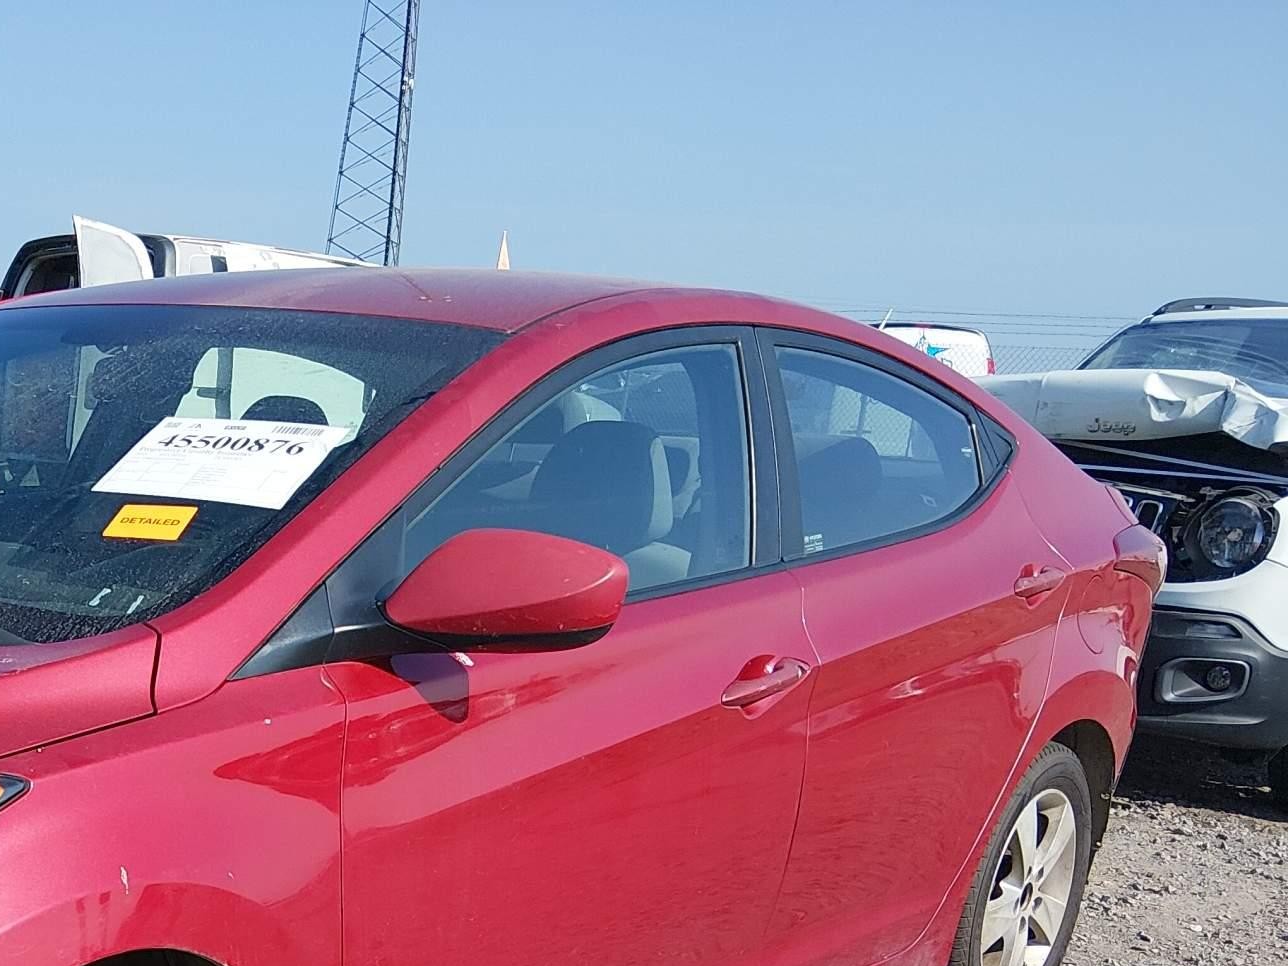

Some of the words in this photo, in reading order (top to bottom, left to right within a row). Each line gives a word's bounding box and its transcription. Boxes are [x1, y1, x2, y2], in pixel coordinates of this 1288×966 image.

[1087, 417, 1137, 436] Jeep
[158, 434, 312, 456] 45500876
[119, 517, 181, 526] DETAILED
